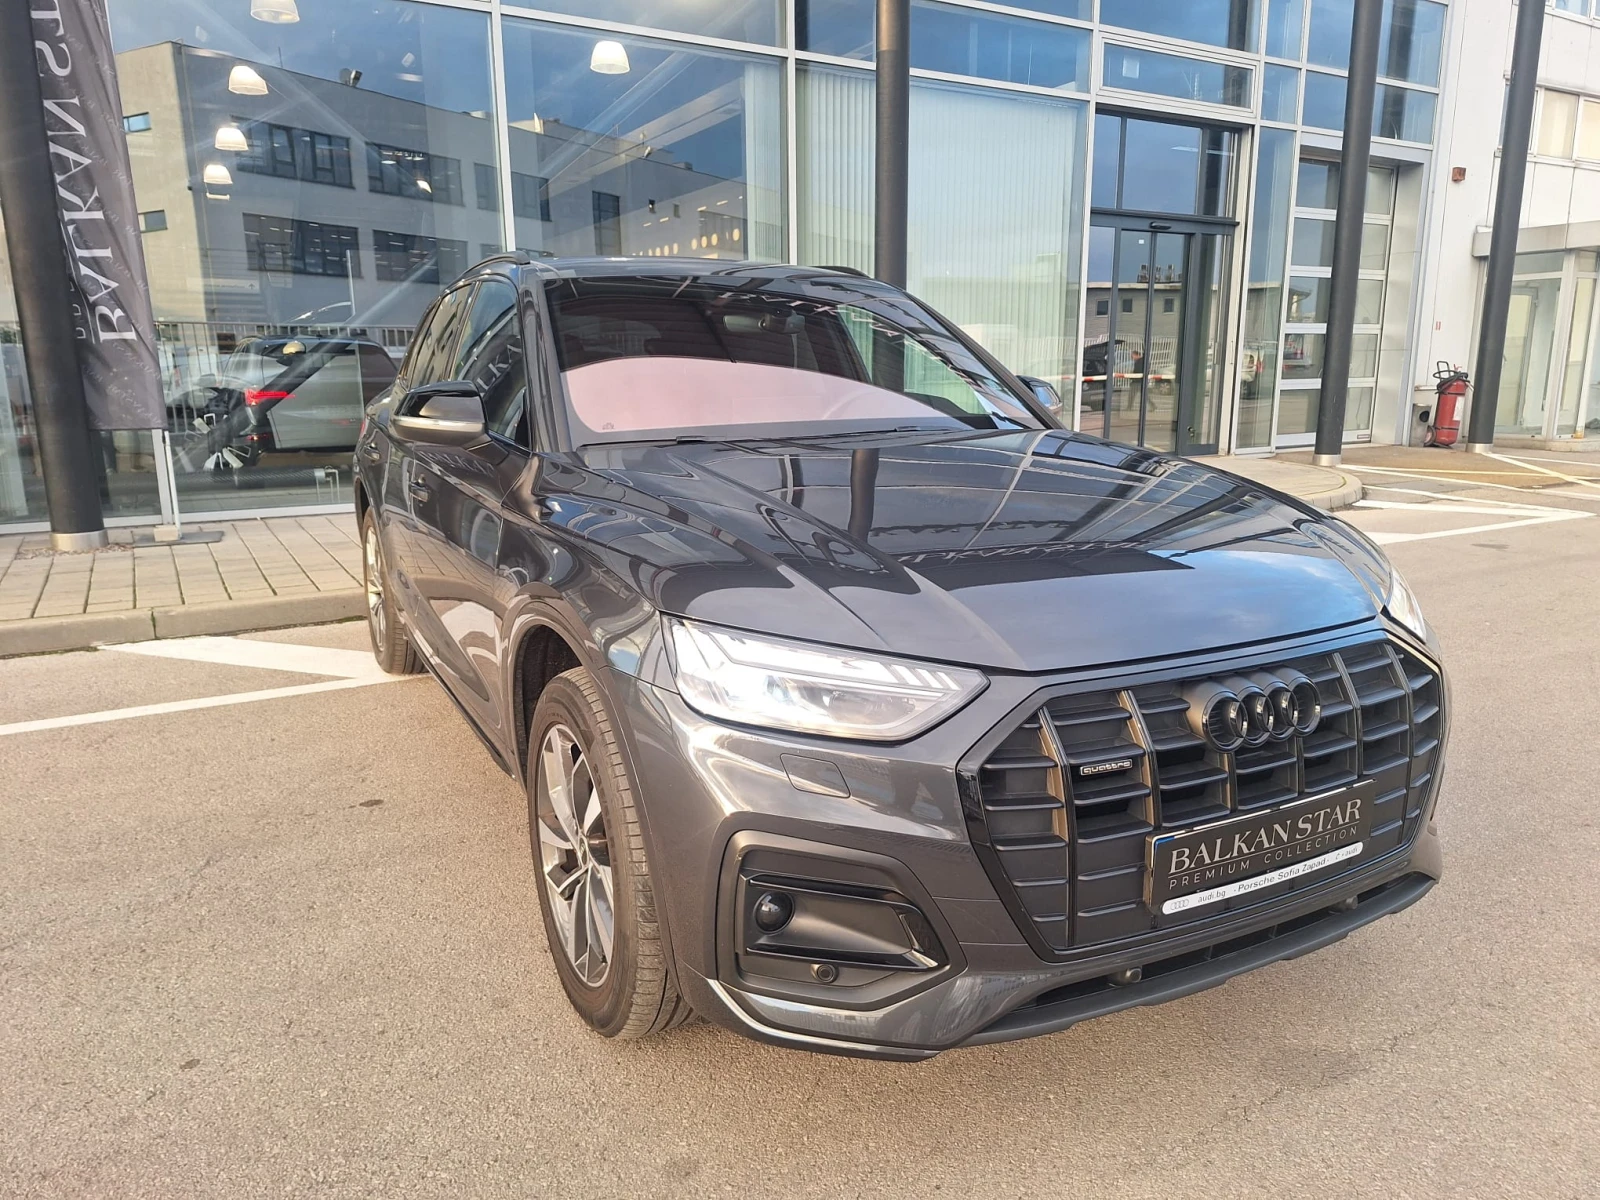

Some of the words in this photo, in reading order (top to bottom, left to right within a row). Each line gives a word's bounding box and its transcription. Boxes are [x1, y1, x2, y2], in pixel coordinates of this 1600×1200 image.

[1083, 761, 1131, 774] quattro
[1168, 819, 1291, 874] BALKAN
[1295, 799, 1362, 839] STAR
[1169, 860, 1250, 890] PREMIUM
[1264, 826, 1358, 864] COLLECTION
[1197, 889, 1226, 903] audi.bg
[1237, 874, 1275, 892] Porsche
[1277, 867, 1300, 881] Sofia
[1302, 857, 1327, 874] Zapad
